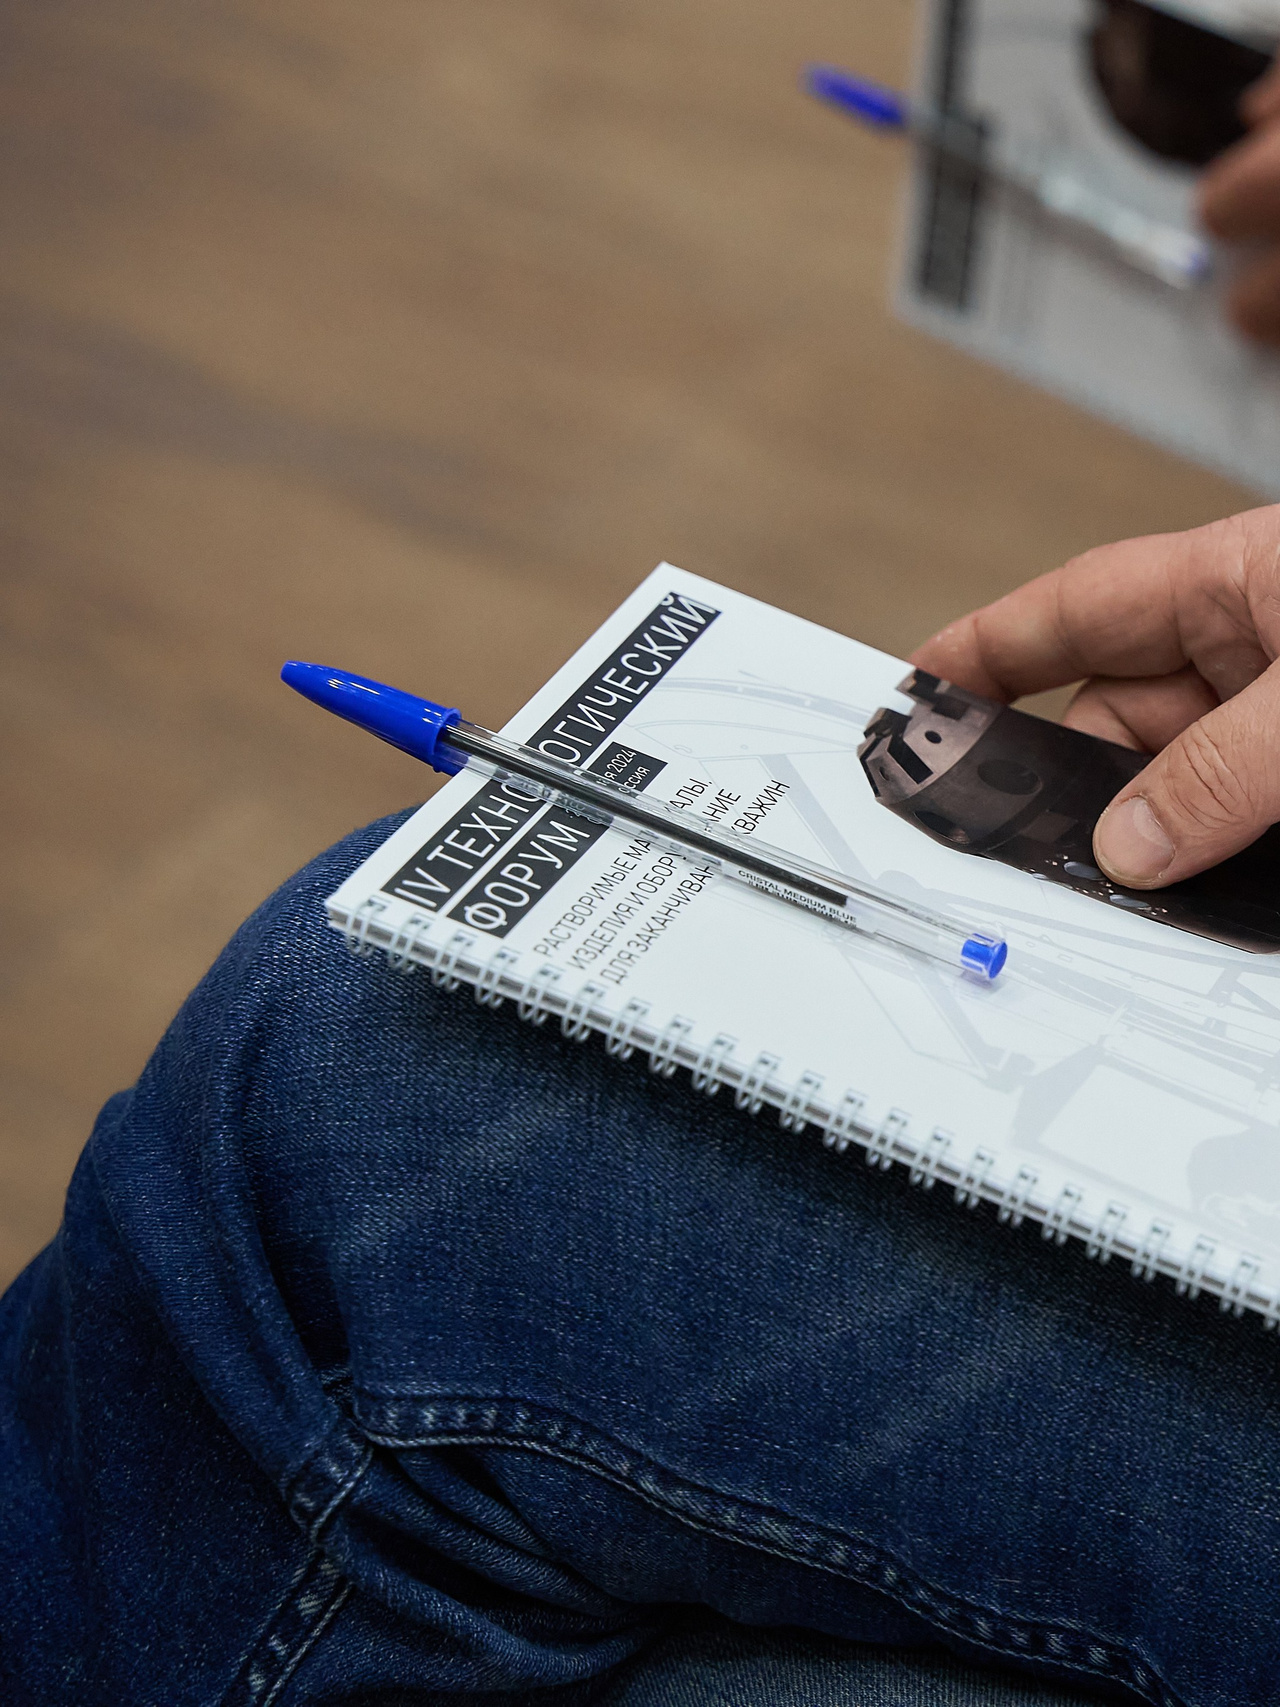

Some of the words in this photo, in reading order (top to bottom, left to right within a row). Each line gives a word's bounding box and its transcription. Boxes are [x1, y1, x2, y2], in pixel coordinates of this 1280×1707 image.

[395, 866, 450, 908] IV
[427, 595, 717, 870] ТЕХНОГИЧЕСКИЙ
[606, 749, 637, 773] 2024
[464, 820, 590, 930] ФОРУМ
[533, 857, 638, 957] РАСТВОРИМЫЕ
[738, 869, 782, 893] CRISTAL
[784, 888, 827, 911] MEDIUM
[828, 906, 857, 923] BLUE
[567, 902, 639, 971] ИЗДЕЛИЯ
[625, 891, 650, 906] И
[600, 949, 640, 985] ДЛЯ
